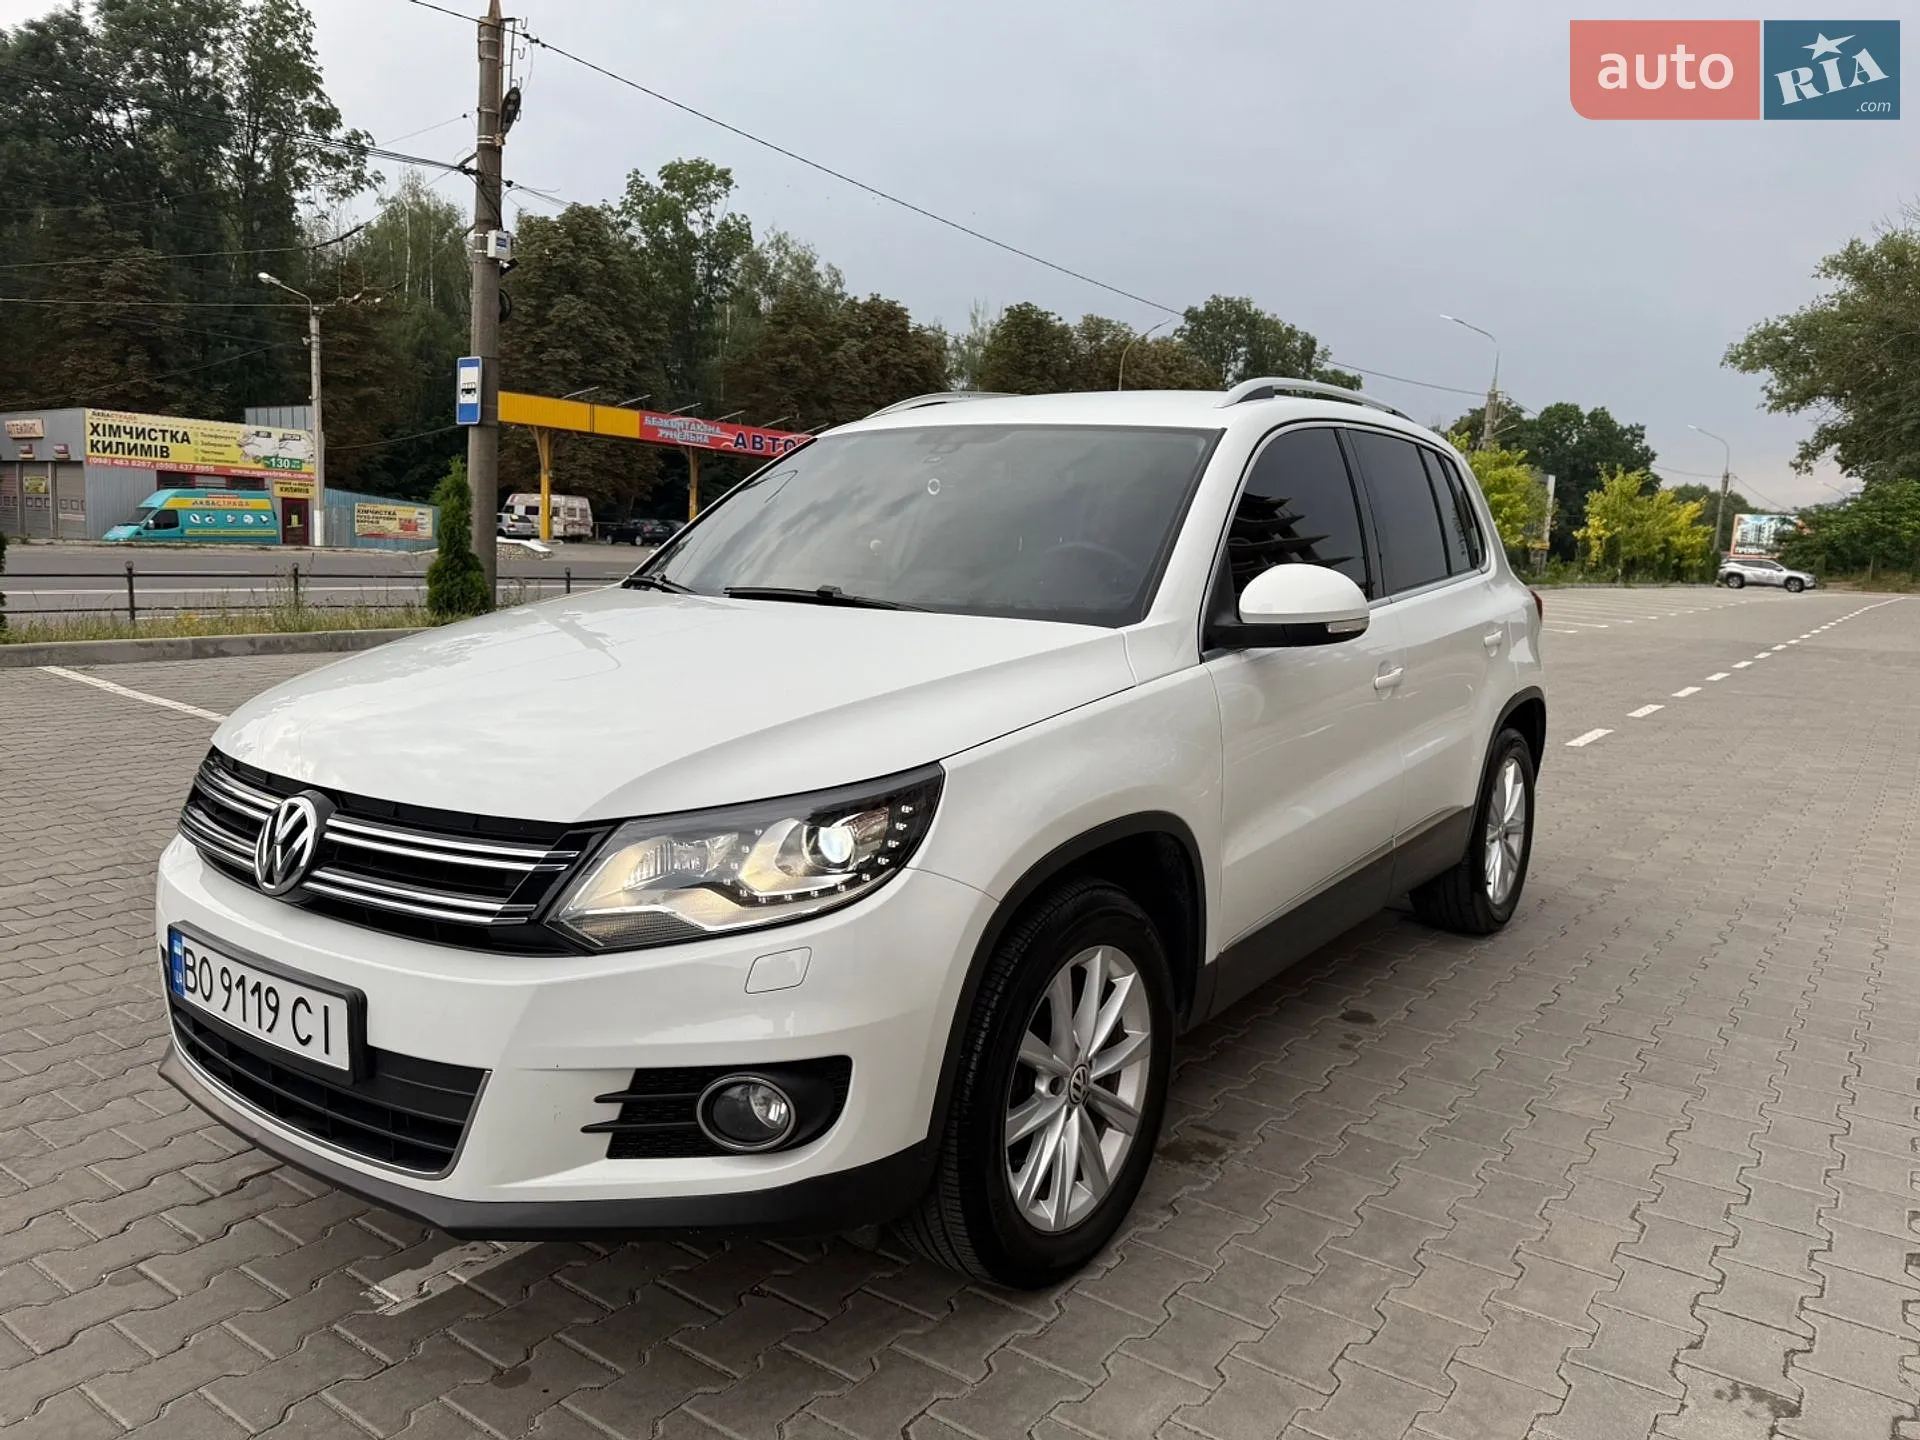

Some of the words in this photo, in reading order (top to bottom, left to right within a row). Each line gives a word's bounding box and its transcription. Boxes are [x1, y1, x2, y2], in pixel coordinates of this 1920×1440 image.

[89, 422, 191, 445] ХІМЧИСТКА
[90, 439, 170, 459] КИЛИМІВ
[183, 946, 214, 1003] BO
[219, 966, 280, 1034] 9119
[290, 996, 330, 1055] CI
